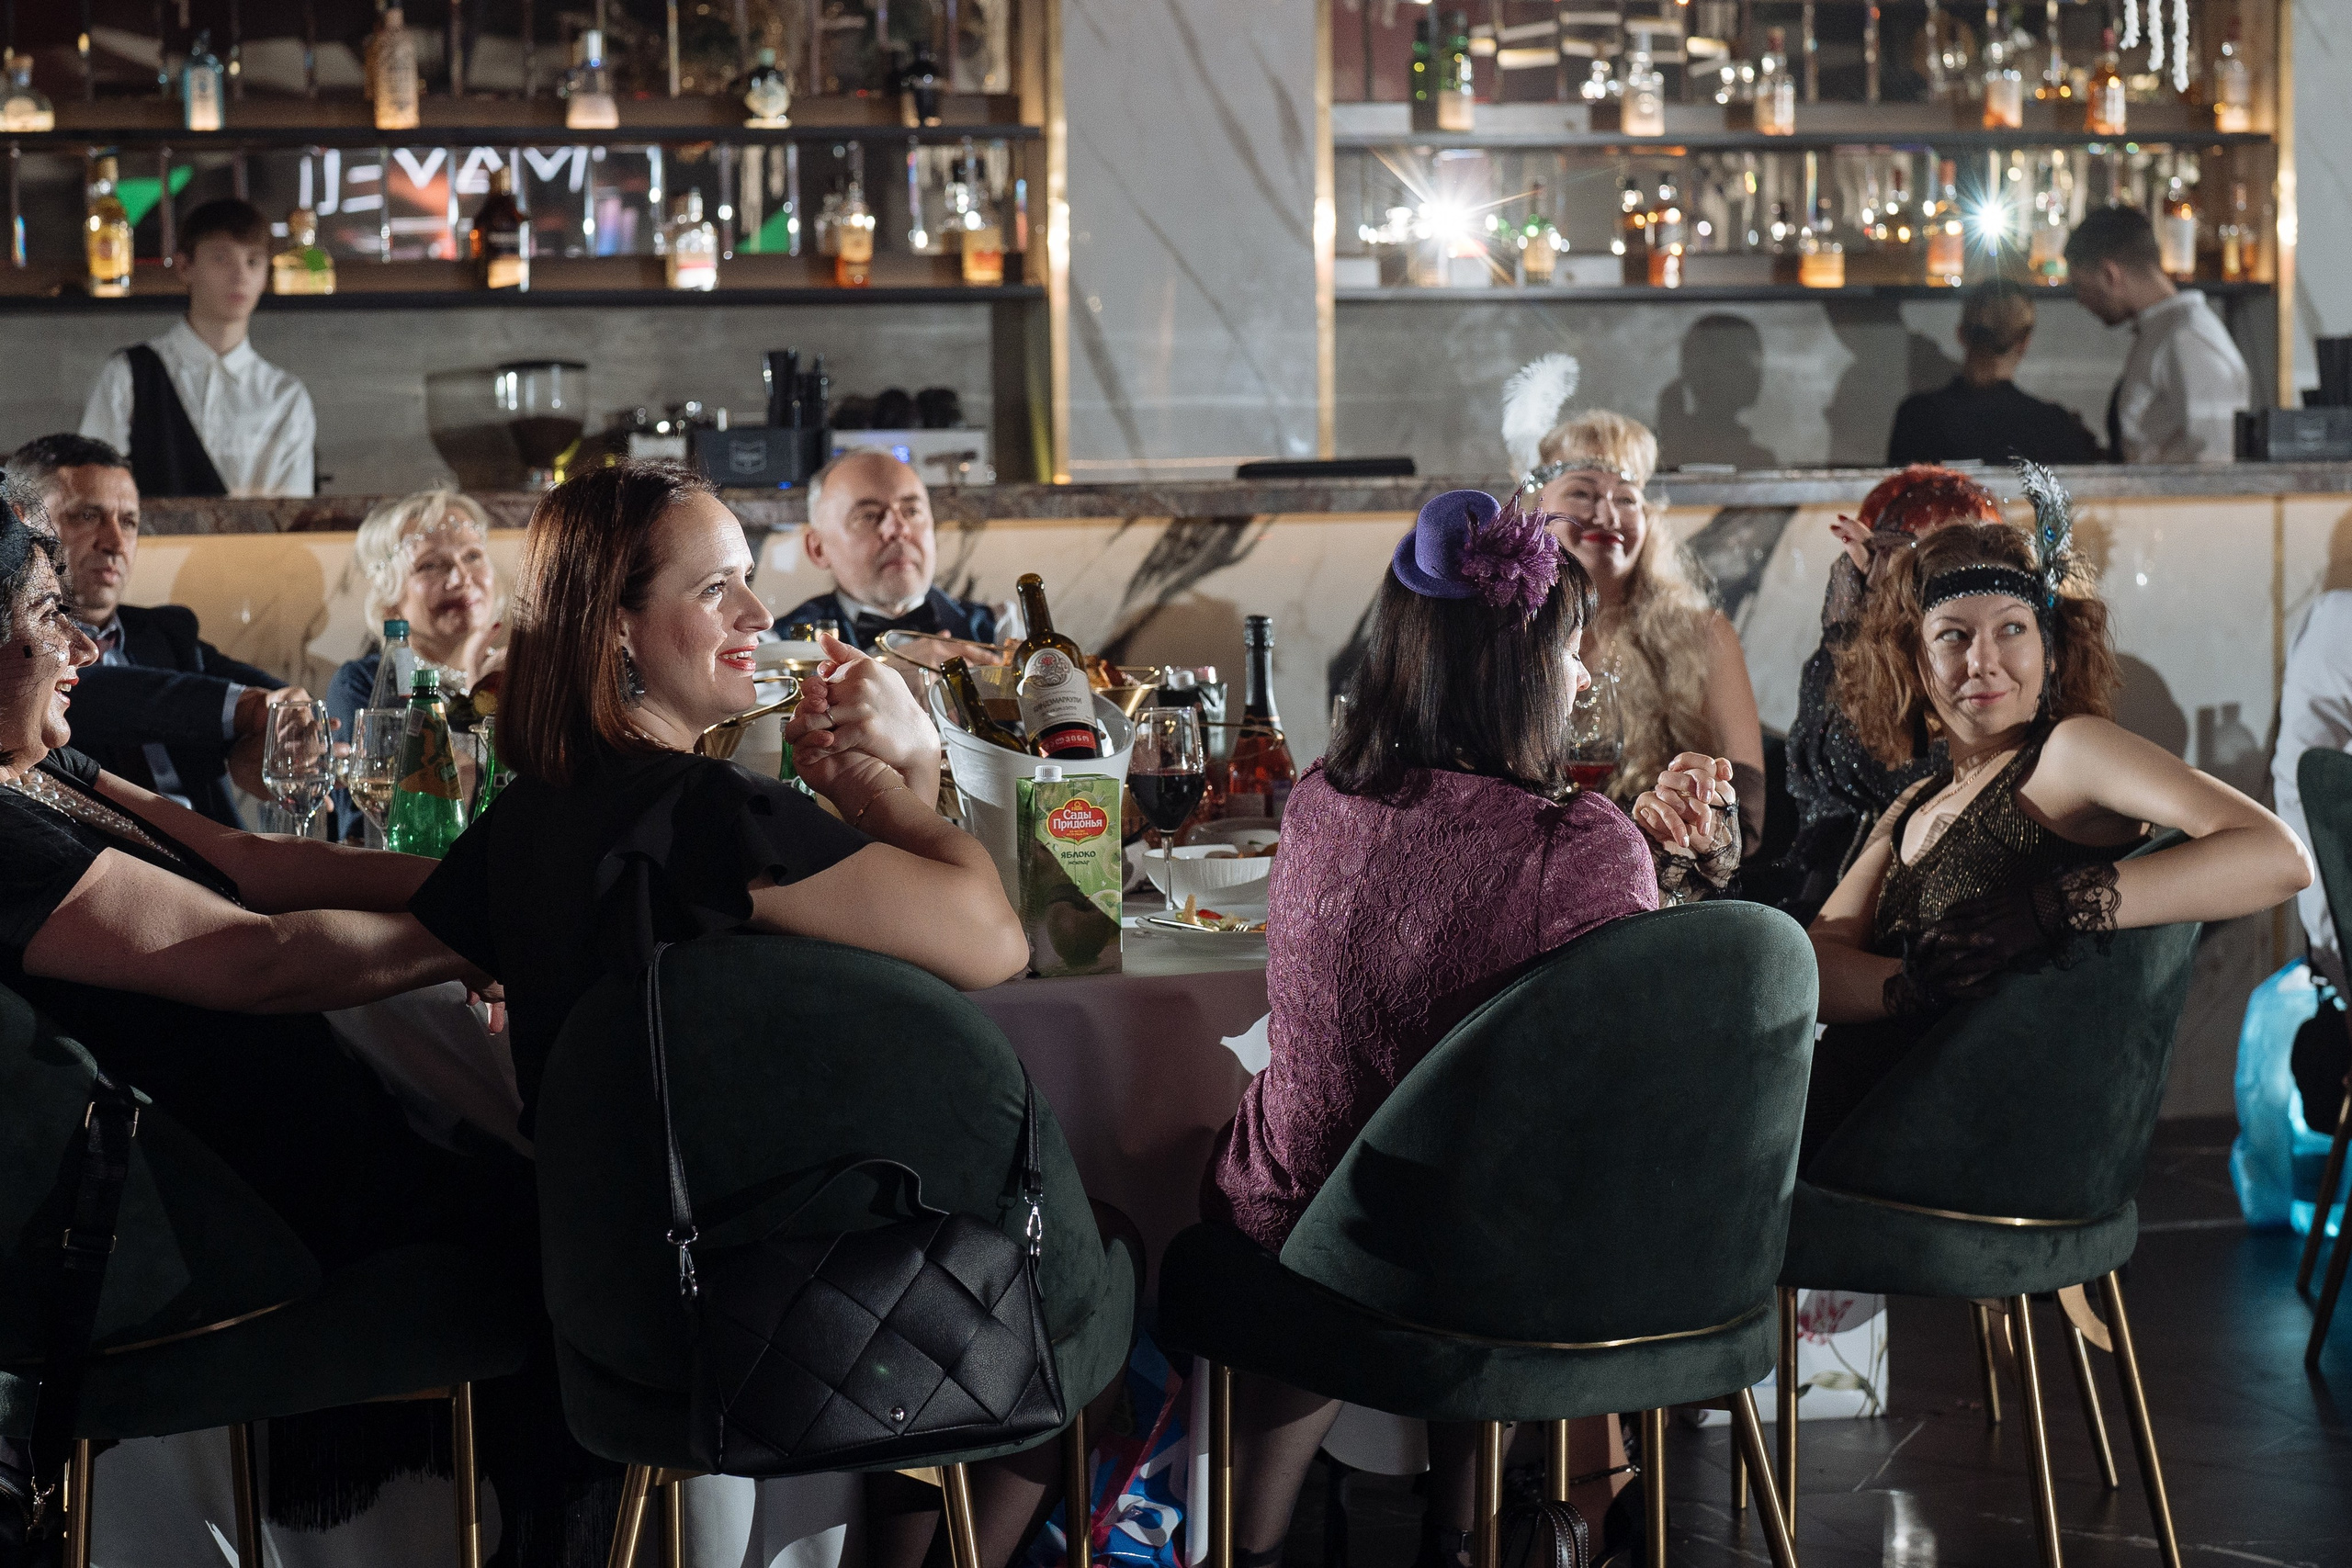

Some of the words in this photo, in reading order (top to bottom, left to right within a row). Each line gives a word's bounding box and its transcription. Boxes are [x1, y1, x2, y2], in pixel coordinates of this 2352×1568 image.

[1063, 809, 1091, 820] Сады
[1053, 818, 1102, 831] Придонья
[1060, 850, 1096, 859] ЯБЛОКО
